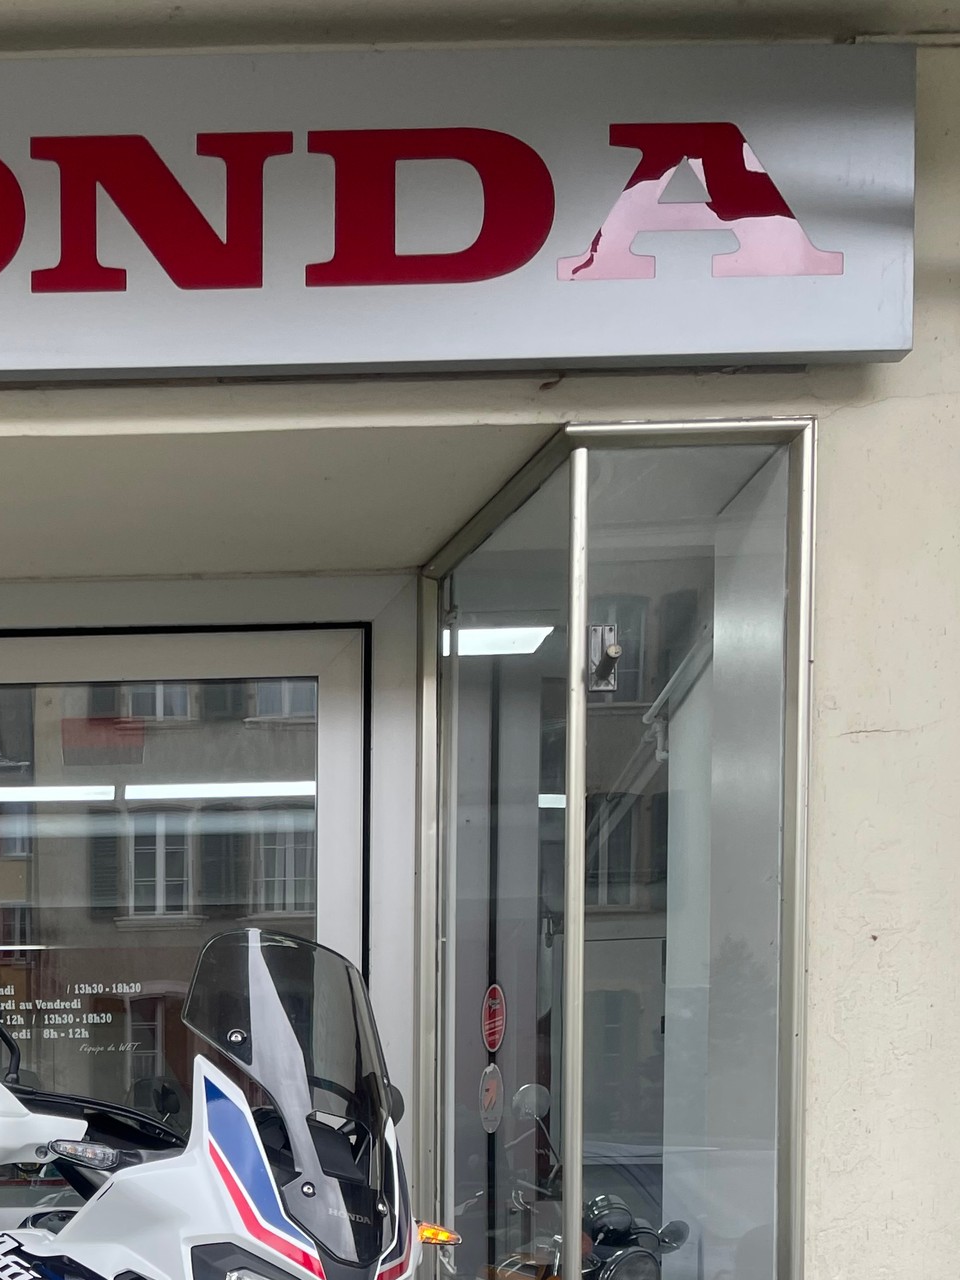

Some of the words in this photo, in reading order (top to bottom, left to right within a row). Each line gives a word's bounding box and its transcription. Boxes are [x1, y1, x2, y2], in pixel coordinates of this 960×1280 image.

[74, 984, 103, 994] 13h30
[112, 983, 141, 994] 18h30
[35, 999, 81, 1009] Vendredi
[6, 1014, 25, 1025] 12h
[44, 1014, 73, 1024] 13h30
[82, 1013, 112, 1024] 18h30
[43, 1029, 58, 1039] 8h
[68, 1028, 90, 1039] 12h
[327, 1207, 371, 1225] HONDA
